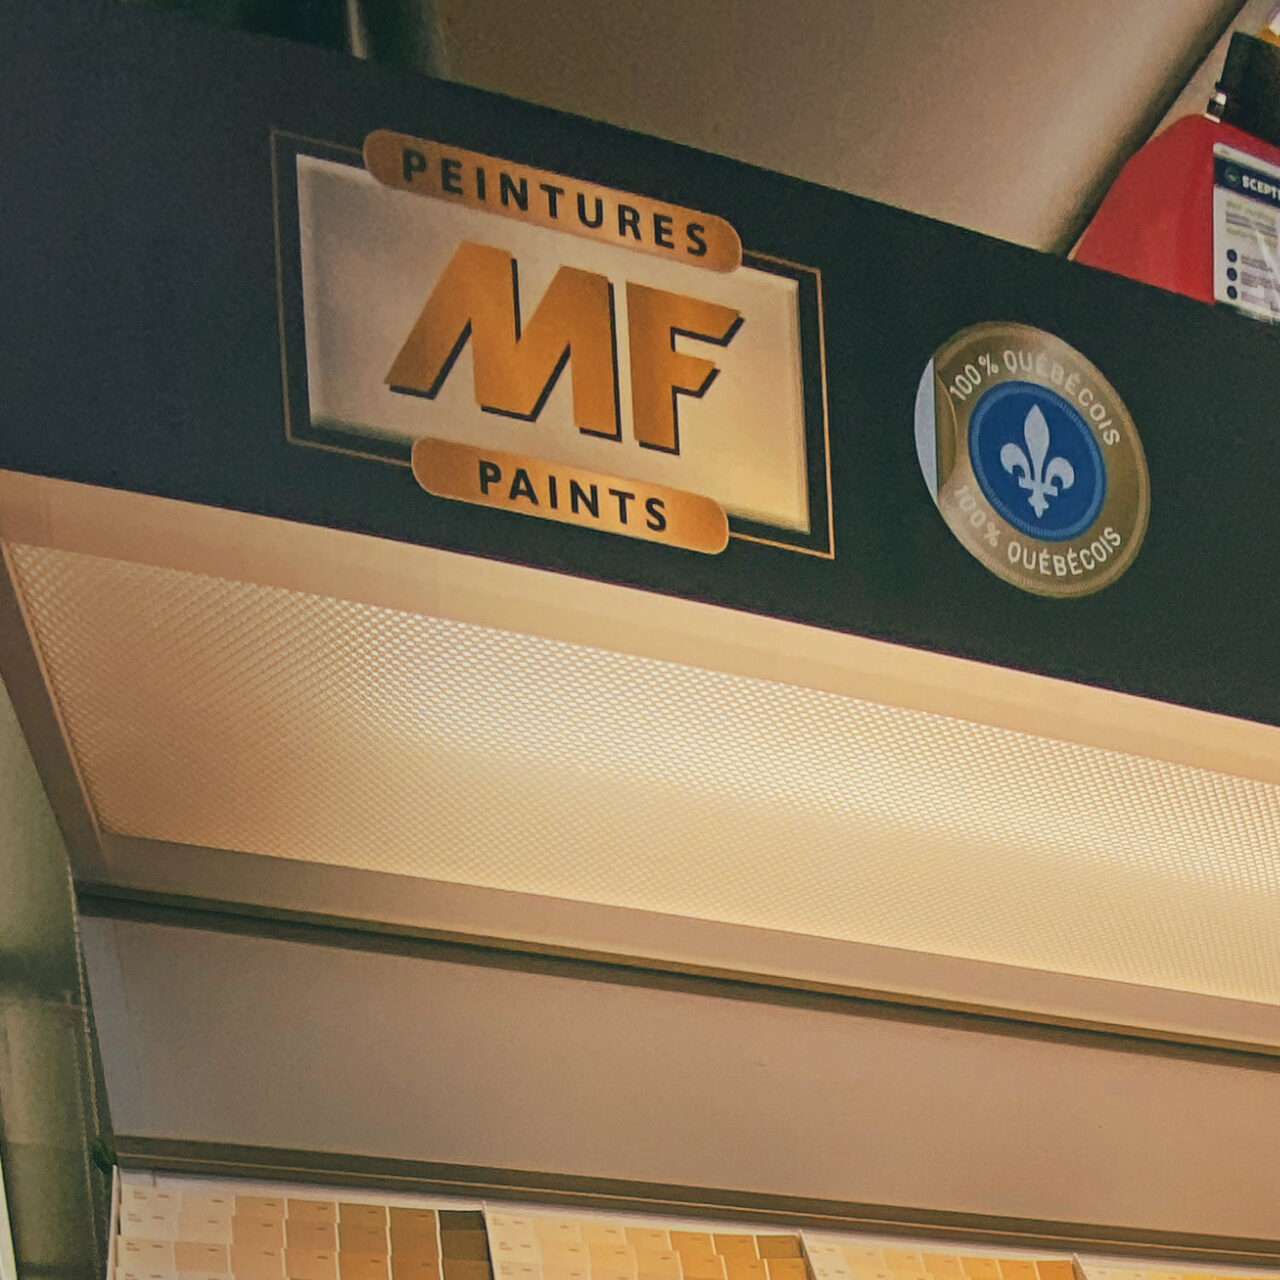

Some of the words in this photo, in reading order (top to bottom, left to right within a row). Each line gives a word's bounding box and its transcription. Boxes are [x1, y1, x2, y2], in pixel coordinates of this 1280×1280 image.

[401, 147, 709, 257] PEINTURES
[384, 239, 745, 456] MF
[1003, 350, 1121, 446] QUÉBÉCOIS
[477, 460, 668, 533] PAINTS
[1007, 526, 1122, 577] QUÉBÉCOIS
